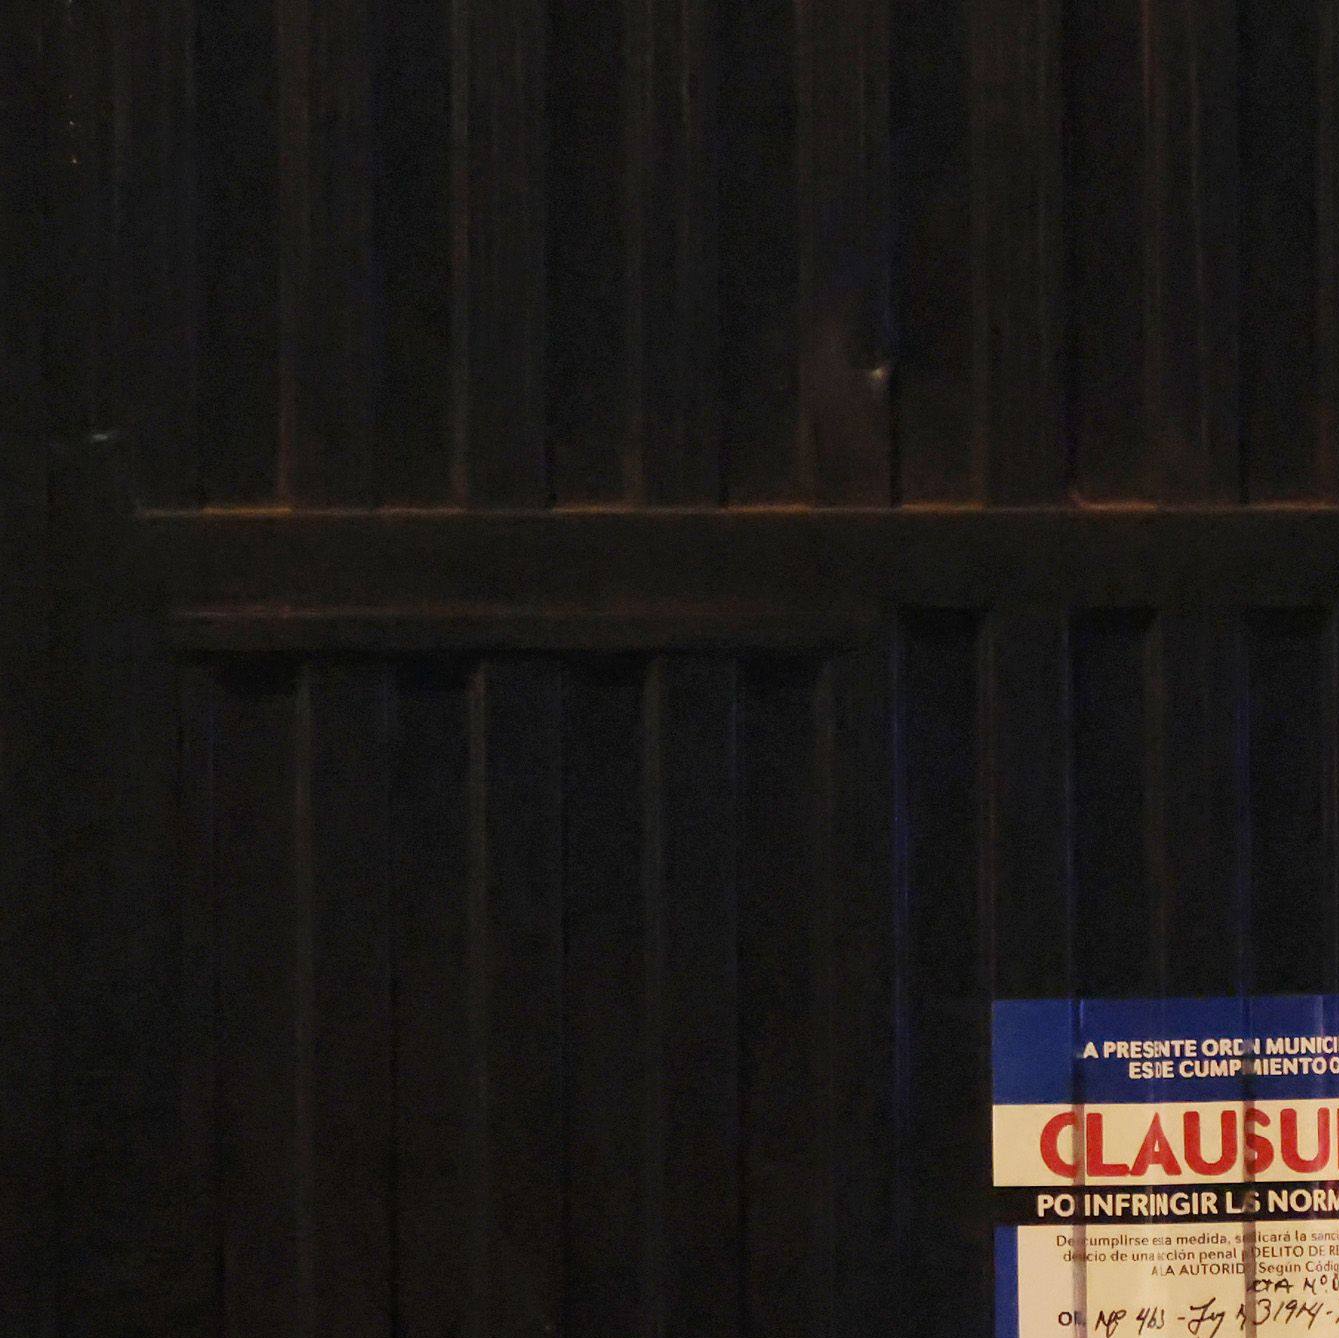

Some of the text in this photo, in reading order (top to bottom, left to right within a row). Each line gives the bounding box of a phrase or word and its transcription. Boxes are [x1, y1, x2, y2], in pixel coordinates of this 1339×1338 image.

[1201, 1037, 1261, 1057] ORDN
[1037, 1193, 1077, 1219] PO
[1084, 1191, 1218, 1217] INFRINGIR
[1294, 1229, 1307, 1243] la
[1110, 1249, 1128, 1262] de
[1199, 1247, 1237, 1263] penal
[1308, 1245, 1325, 1258] DE
